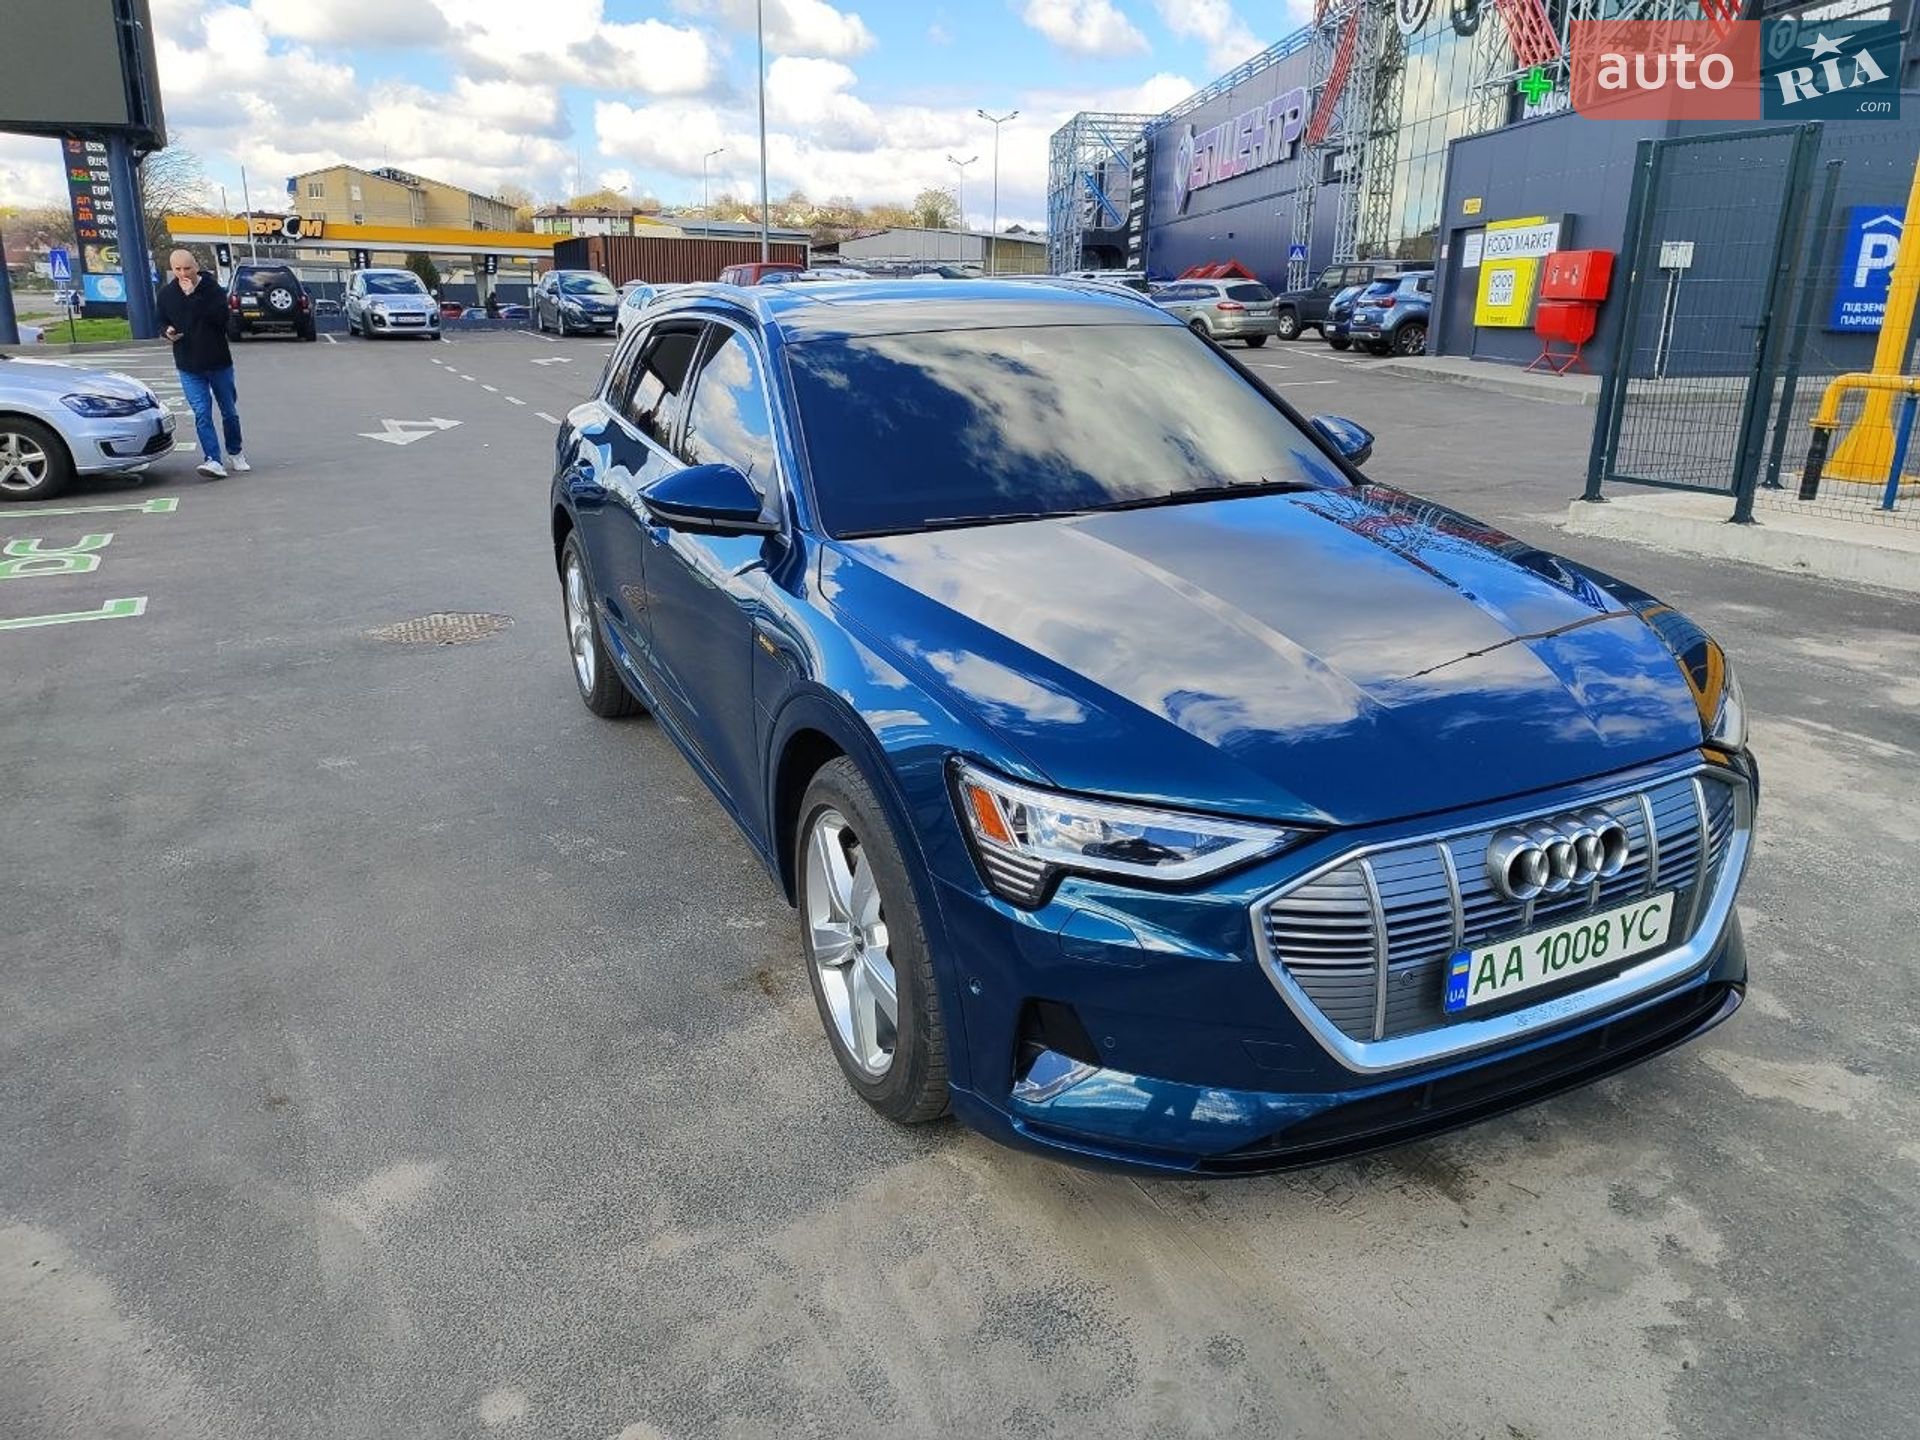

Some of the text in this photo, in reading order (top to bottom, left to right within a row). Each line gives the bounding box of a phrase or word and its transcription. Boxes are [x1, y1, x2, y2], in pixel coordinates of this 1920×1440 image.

[1486, 234, 1513, 254] FOOD
[1515, 230, 1554, 251] MARKET
[1490, 274, 1513, 289] FOOD
[1473, 903, 1661, 997] AA 1008 YC
[1450, 988, 1467, 1002] UA
